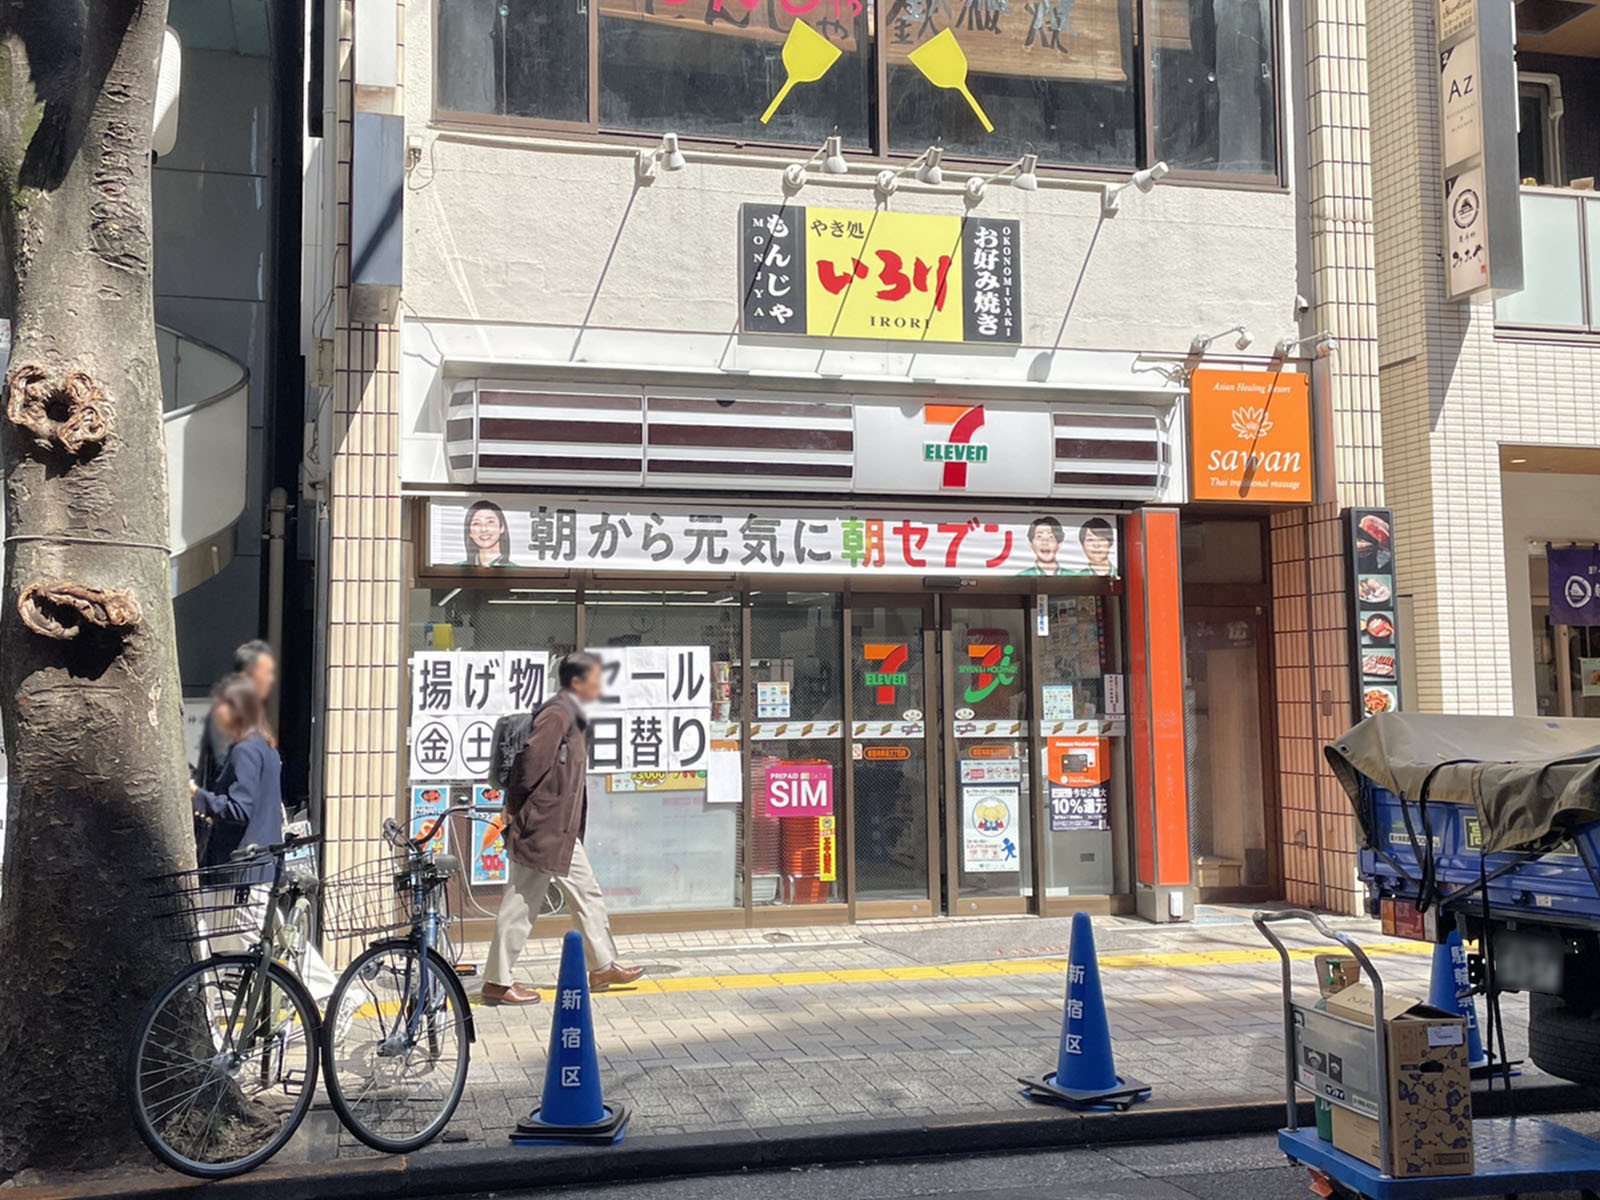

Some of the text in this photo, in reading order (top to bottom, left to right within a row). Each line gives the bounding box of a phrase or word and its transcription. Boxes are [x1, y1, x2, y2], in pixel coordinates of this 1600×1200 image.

[1448, 74, 1473, 104] AZ
[810, 219, 865, 239] やき処
[752, 217, 765, 317] MONJYA
[766, 214, 794, 325] もんじゃ
[816, 249, 952, 312] いろり
[972, 226, 1001, 336] お好み焼き
[1002, 226, 1013, 337] OKONOMIYAKI
[869, 315, 931, 330] IRORI
[1208, 449, 1301, 473] sawan
[528, 506, 1013, 568] 朝から元気に朝セブン
[418, 657, 546, 711] 揚げ物
[589, 716, 706, 770] 日替り
[769, 780, 828, 808] SIM
[1051, 797, 1108, 814] 10%還元
[561, 988, 582, 1087] 新宿区
[1065, 963, 1085, 1055] 新宿区
